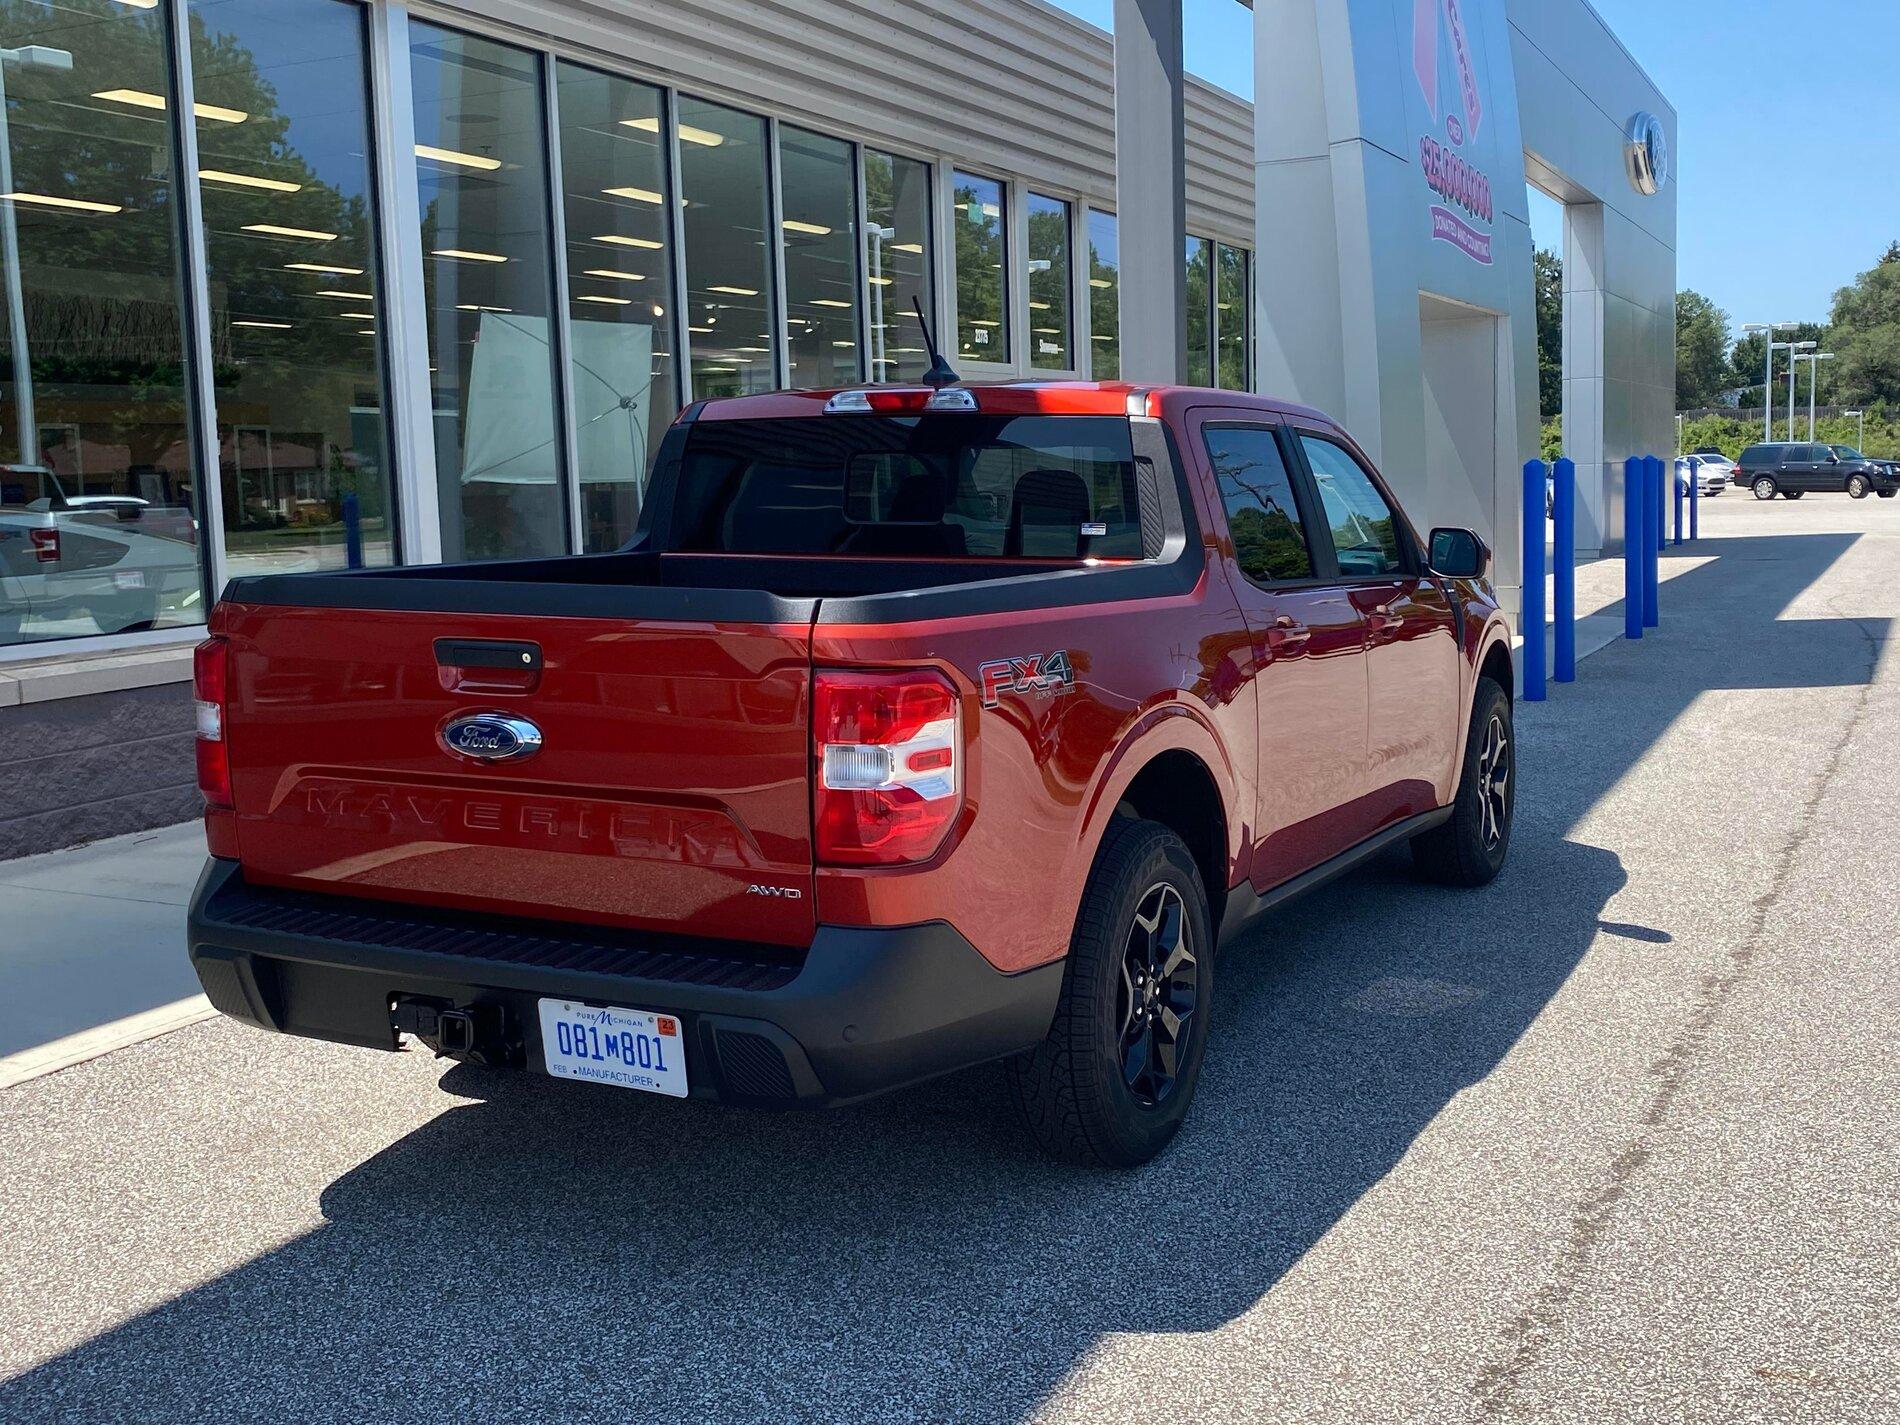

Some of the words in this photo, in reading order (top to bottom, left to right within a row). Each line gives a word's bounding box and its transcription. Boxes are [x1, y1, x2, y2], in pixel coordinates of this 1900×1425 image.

[978, 650, 1074, 710] FX4
[459, 725, 502, 749] Ford
[306, 787, 714, 855] MAVERICK
[745, 884, 801, 899] AWD
[576, 1012, 596, 1021] PURE
[593, 1010, 643, 1027] MICHIGAN
[662, 1020, 674, 1030] 23
[557, 1021, 668, 1072] 081M801
[553, 1064, 568, 1074] FEB
[578, 1066, 654, 1087] MANUFACTURER
